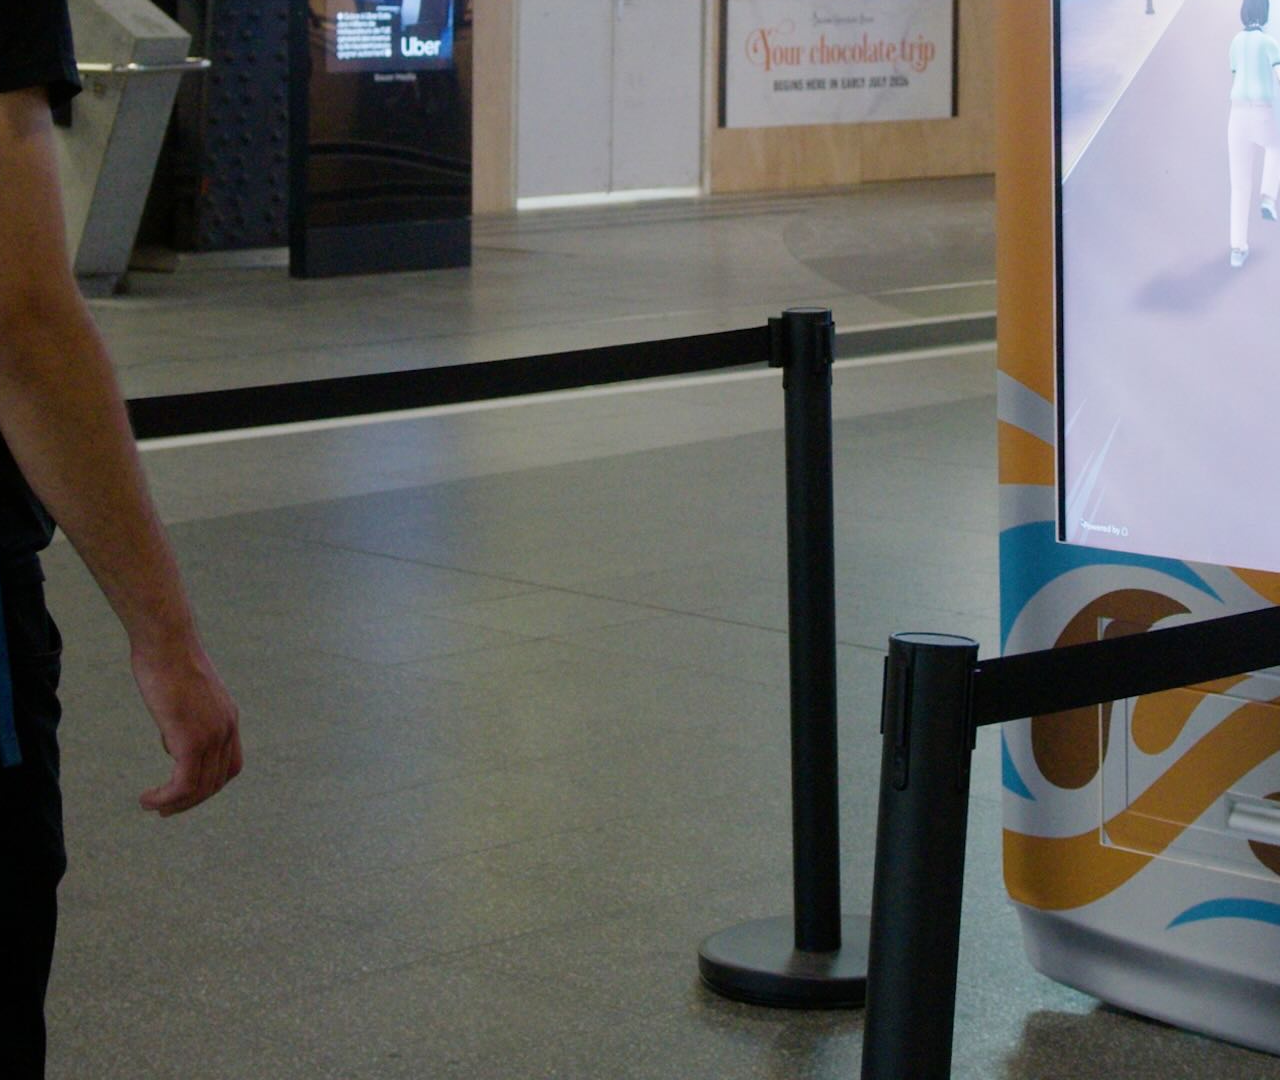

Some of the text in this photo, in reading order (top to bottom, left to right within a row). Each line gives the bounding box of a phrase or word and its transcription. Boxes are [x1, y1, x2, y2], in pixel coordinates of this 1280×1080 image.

[401, 36, 442, 57] Uber
[745, 21, 936, 73] Your chocolate trip
